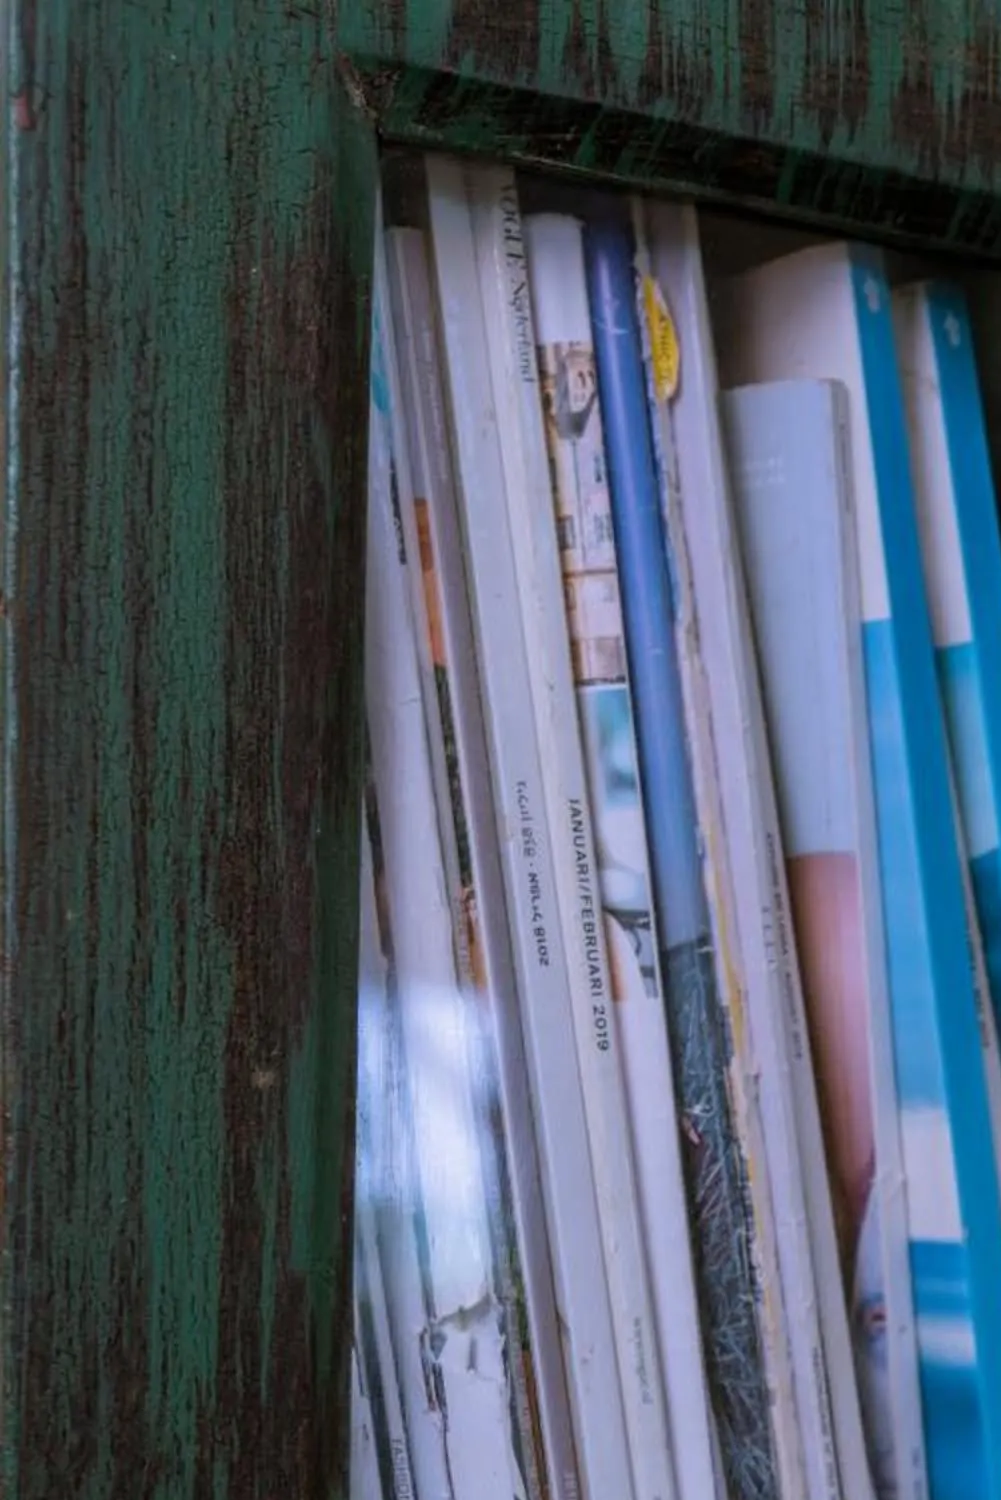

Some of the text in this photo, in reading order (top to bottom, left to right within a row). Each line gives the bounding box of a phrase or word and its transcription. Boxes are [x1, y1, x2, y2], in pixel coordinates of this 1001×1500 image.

[531, 925, 549, 967] 2018
[567, 797, 609, 1051] JANUARI/FEBRUARI 2019
